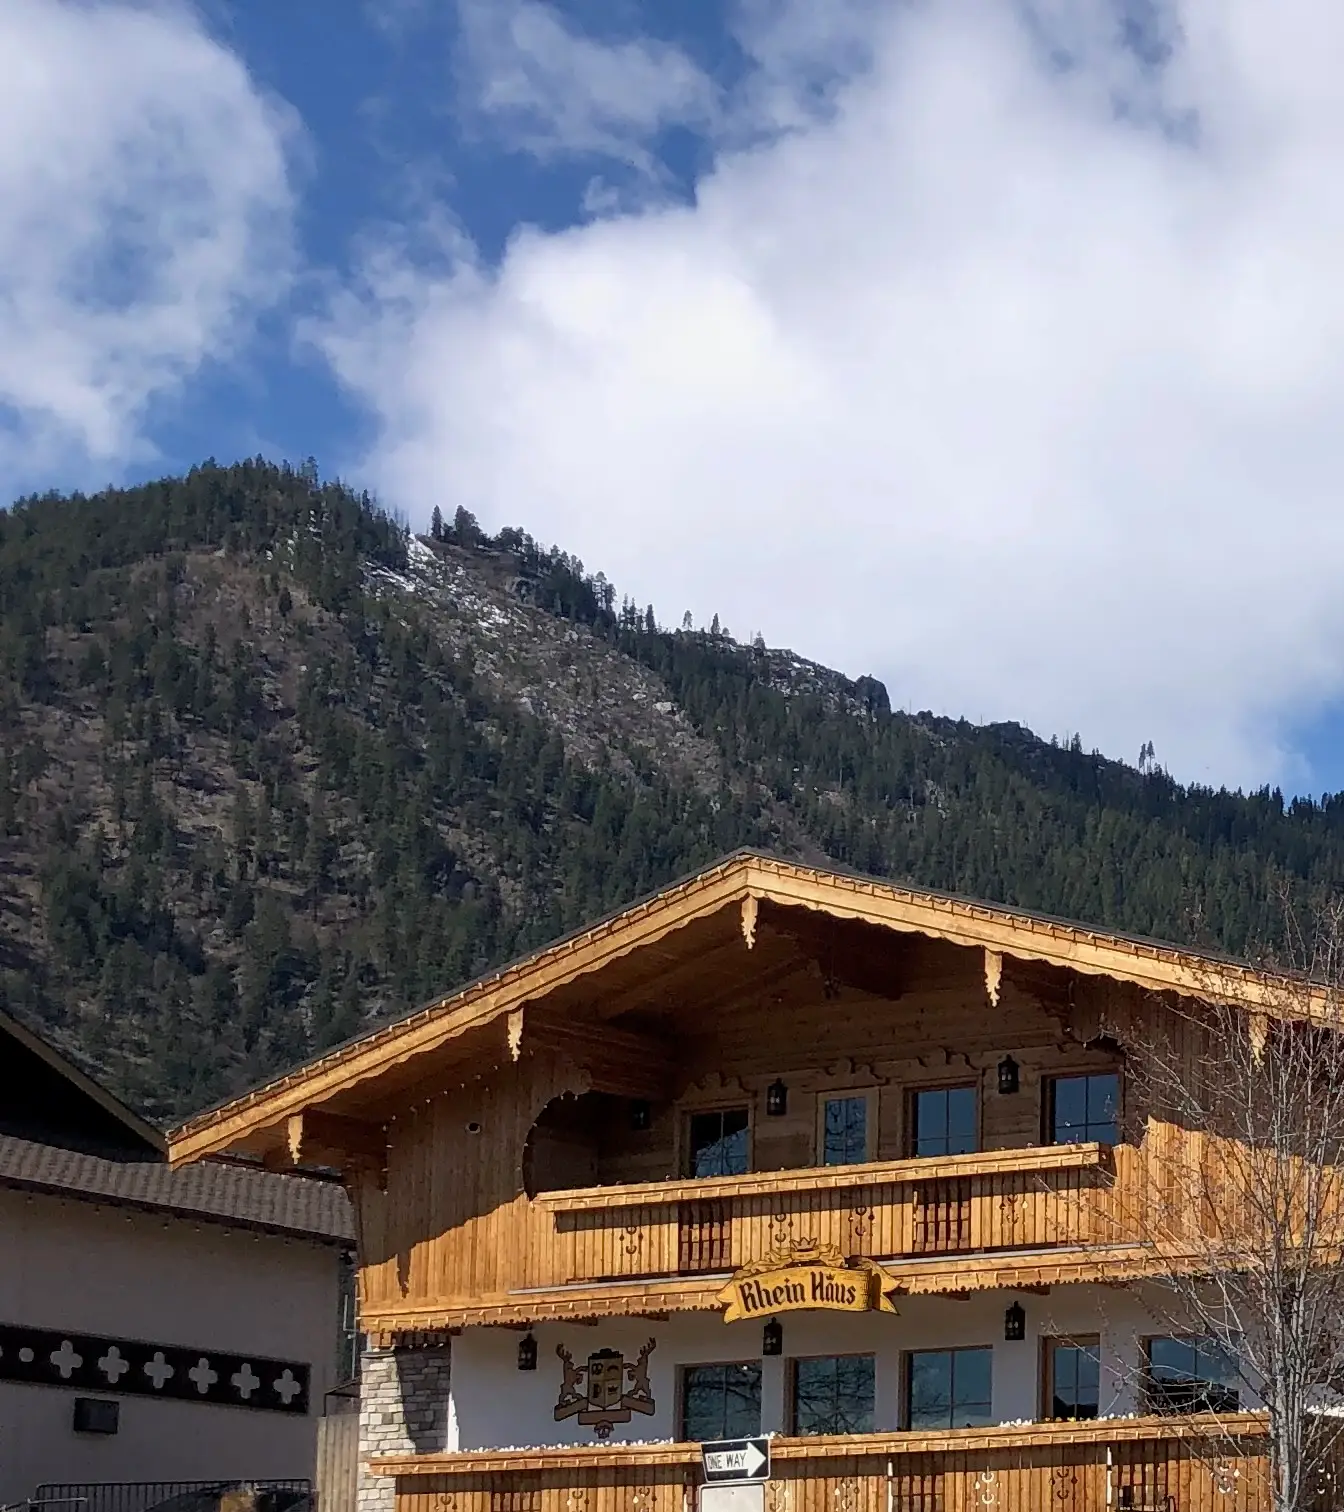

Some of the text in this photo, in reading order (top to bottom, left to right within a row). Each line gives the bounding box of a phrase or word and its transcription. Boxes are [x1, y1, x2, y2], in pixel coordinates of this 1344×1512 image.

[739, 1278, 806, 1312] Rhein
[707, 1452, 747, 1469] ONE WAY
